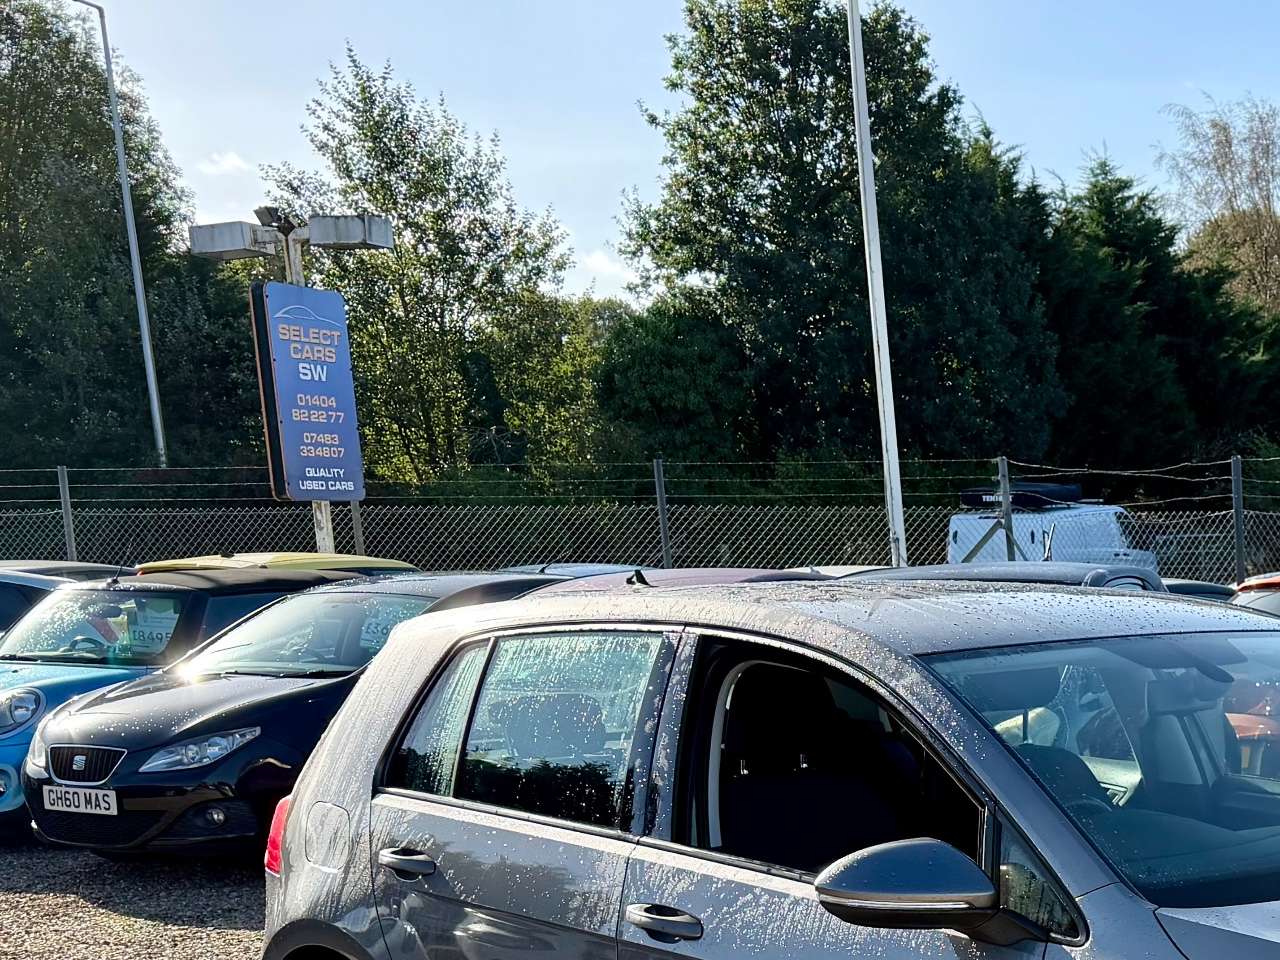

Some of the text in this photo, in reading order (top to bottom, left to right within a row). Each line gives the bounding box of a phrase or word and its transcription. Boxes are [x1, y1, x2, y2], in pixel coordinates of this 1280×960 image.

[279, 324, 341, 346] SELECT
[290, 342, 337, 363] CARS
[298, 362, 328, 382] SW
[297, 394, 337, 408] 01404
[303, 432, 339, 445] 07483
[305, 467, 345, 478] QUALITY
[299, 480, 355, 491] USED CARS
[48, 788, 111, 811] GH60 MAS
